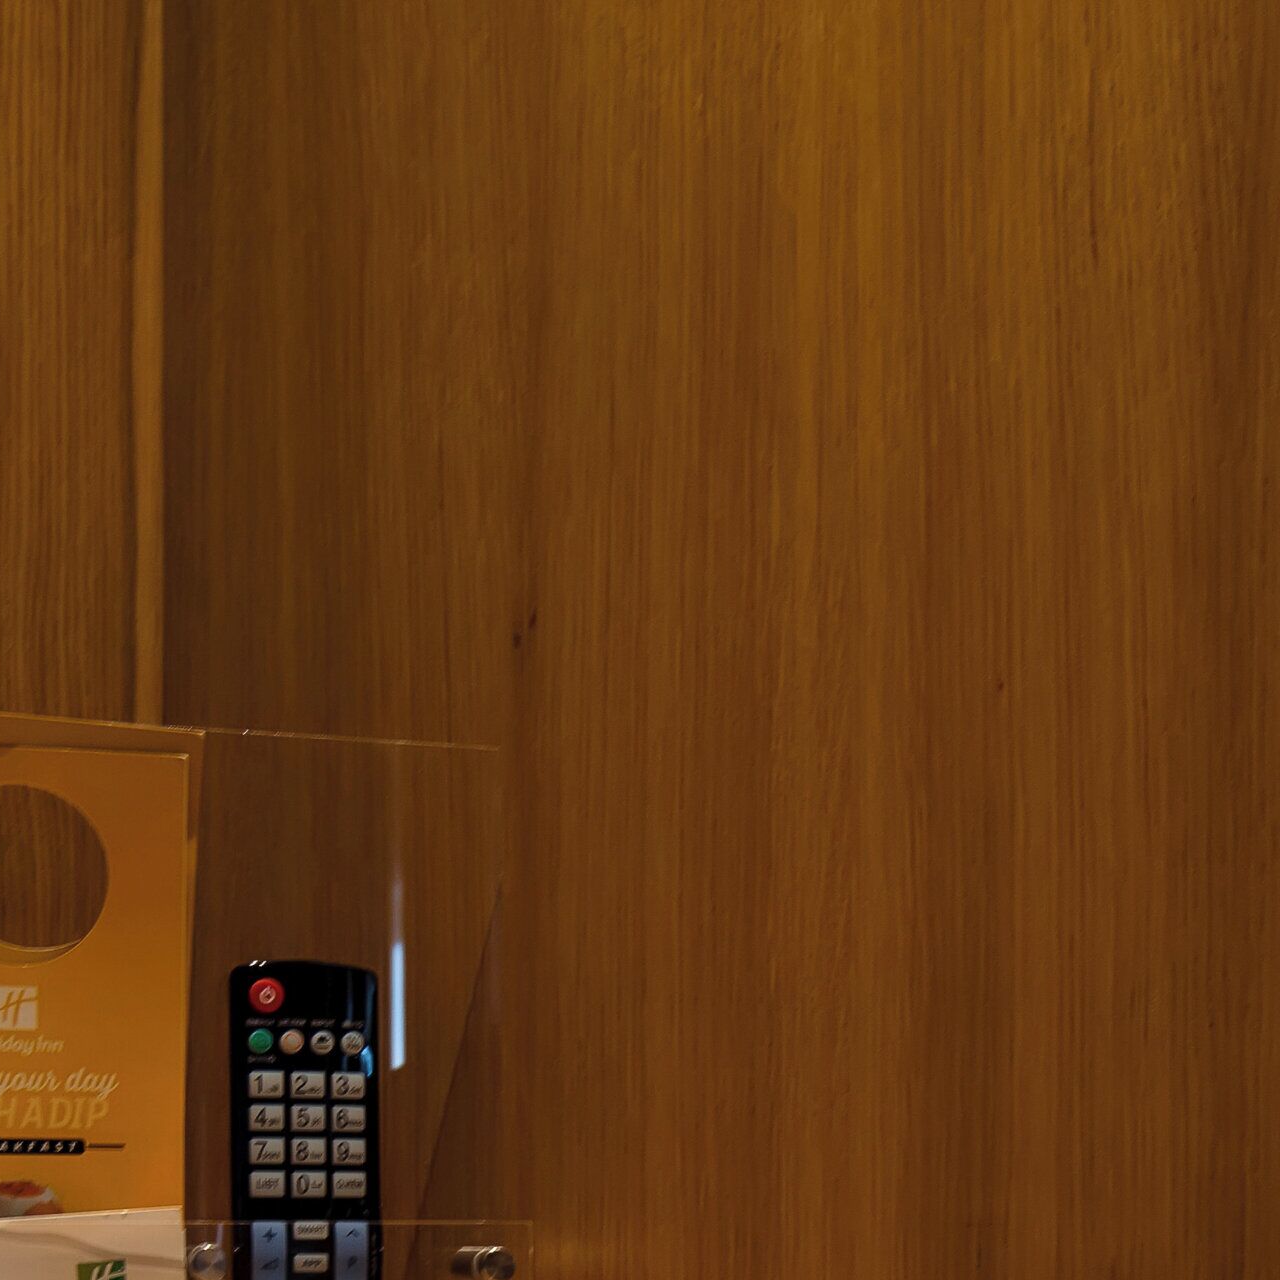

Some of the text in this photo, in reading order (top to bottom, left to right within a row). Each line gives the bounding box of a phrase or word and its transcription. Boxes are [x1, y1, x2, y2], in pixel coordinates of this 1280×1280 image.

[36, 1035, 65, 1053] Inn
[64, 1066, 120, 1101] day
[254, 1074, 264, 1094] 1
[295, 1075, 309, 1095] 2
[336, 1075, 350, 1096] 3
[254, 1107, 268, 1127] 4
[297, 1107, 310, 1128] 5
[336, 1108, 350, 1129] 6
[254, 1141, 268, 1161] 7
[296, 1141, 309, 1161] 8
[337, 1141, 350, 1162] 9
[297, 1174, 310, 1195] 0
